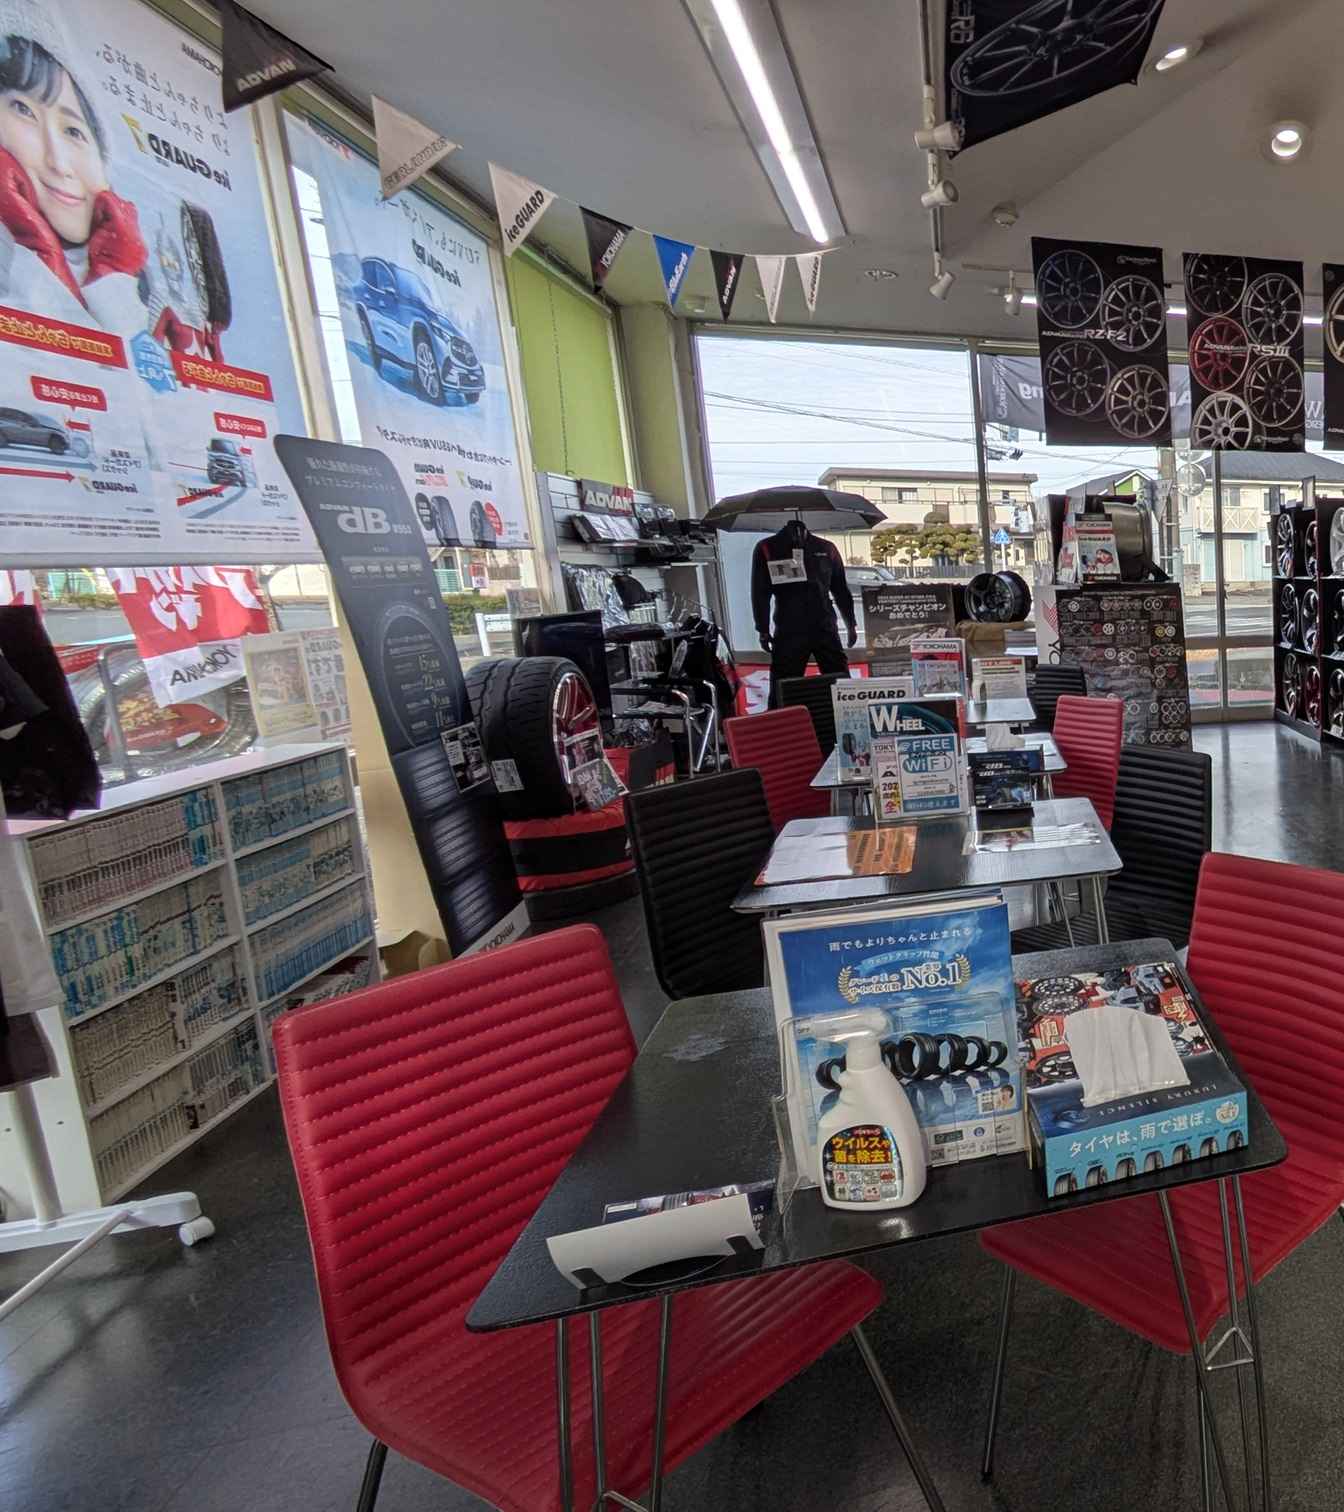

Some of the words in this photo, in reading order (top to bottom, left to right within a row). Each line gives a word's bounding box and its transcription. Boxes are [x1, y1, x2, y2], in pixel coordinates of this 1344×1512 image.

[237, 57, 297, 92] ADVAN
[506, 189, 545, 243] iceGUARD
[600, 229, 625, 269] YOKOHAMA
[584, 488, 635, 509] ADVAN
[337, 505, 392, 535] dB
[868, 603, 947, 613] シリーズチャンピオン
[922, 642, 958, 650] YOKOHAMA
[837, 689, 907, 702] iceGUARD
[869, 704, 926, 733] WHEEL
[873, 743, 896, 751] TOKY
[912, 738, 951, 752] FREE
[901, 962, 962, 991] No.1
[1168, 1083, 1218, 1101] LUXURY
[832, 1137, 892, 1149] ウイルスや
